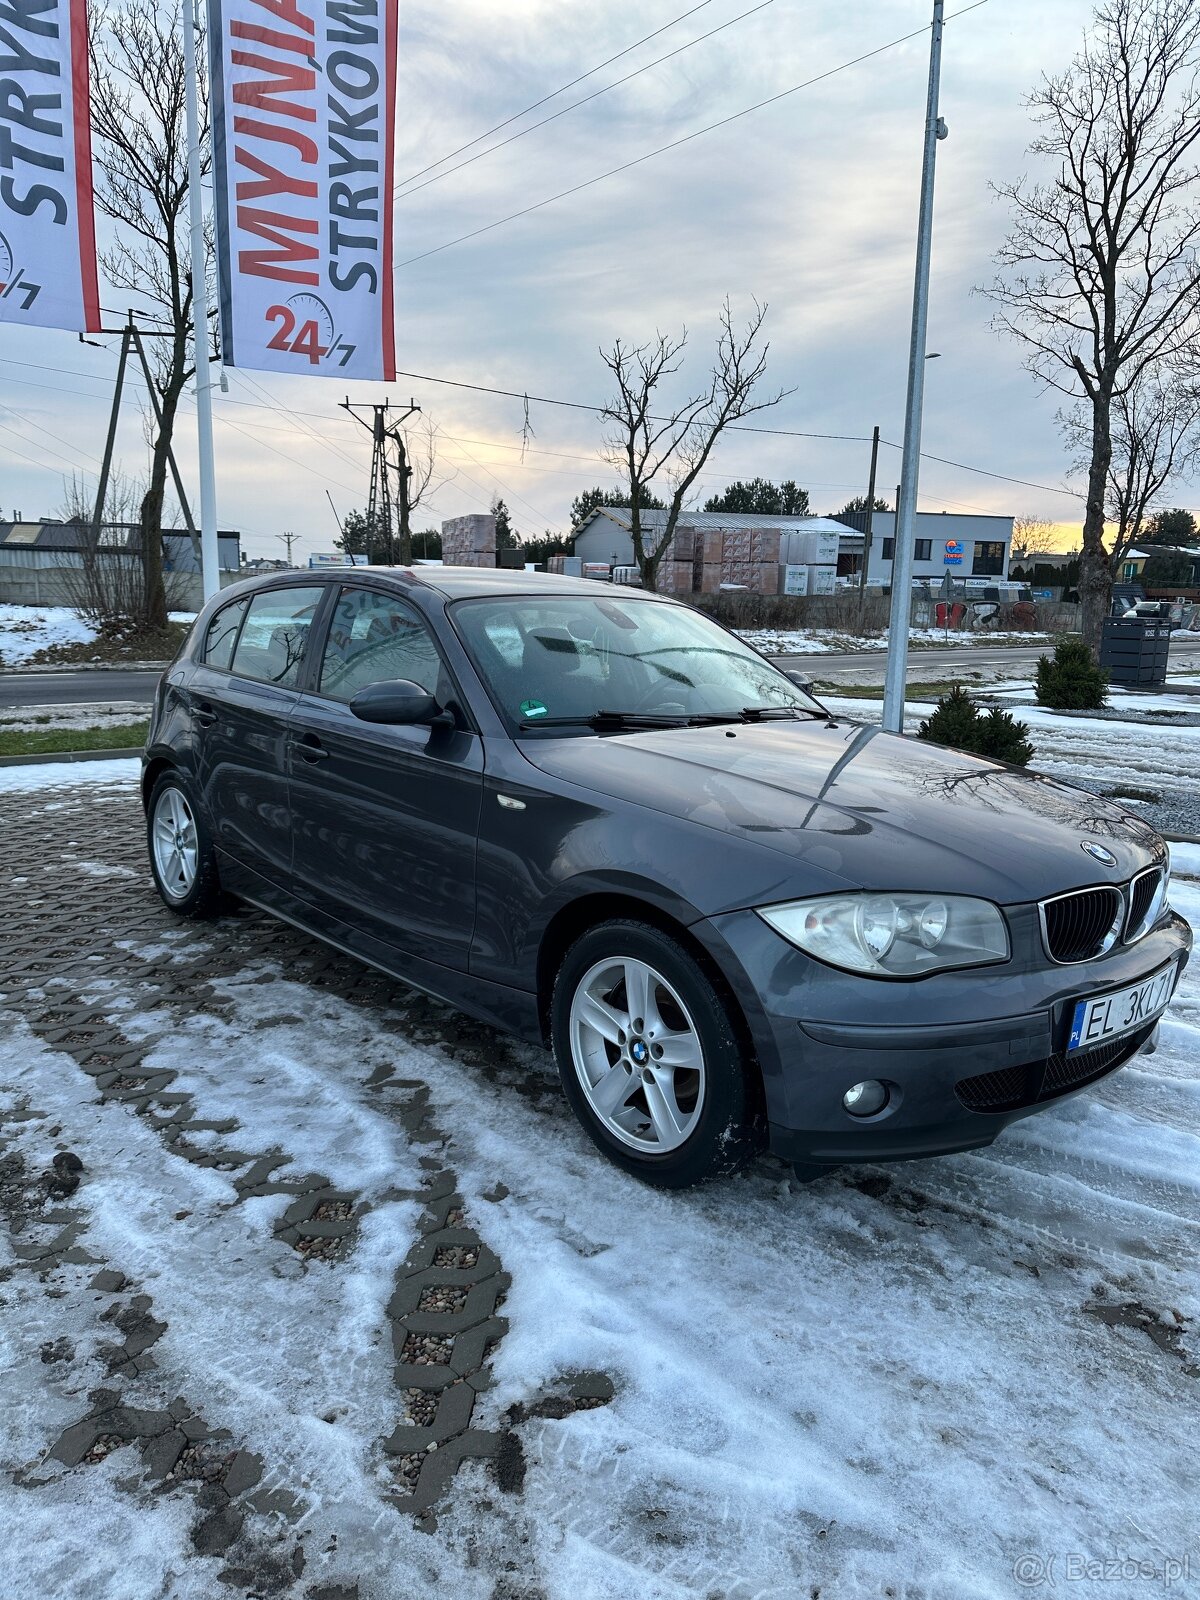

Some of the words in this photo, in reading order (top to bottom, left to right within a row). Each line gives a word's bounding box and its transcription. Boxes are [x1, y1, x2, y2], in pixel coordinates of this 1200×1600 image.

[265, 304, 357, 367] 24/7
[1087, 999, 1113, 1040] EL
[1124, 969, 1173, 1025] 3KL71
[1070, 1031, 1079, 1042] PL
